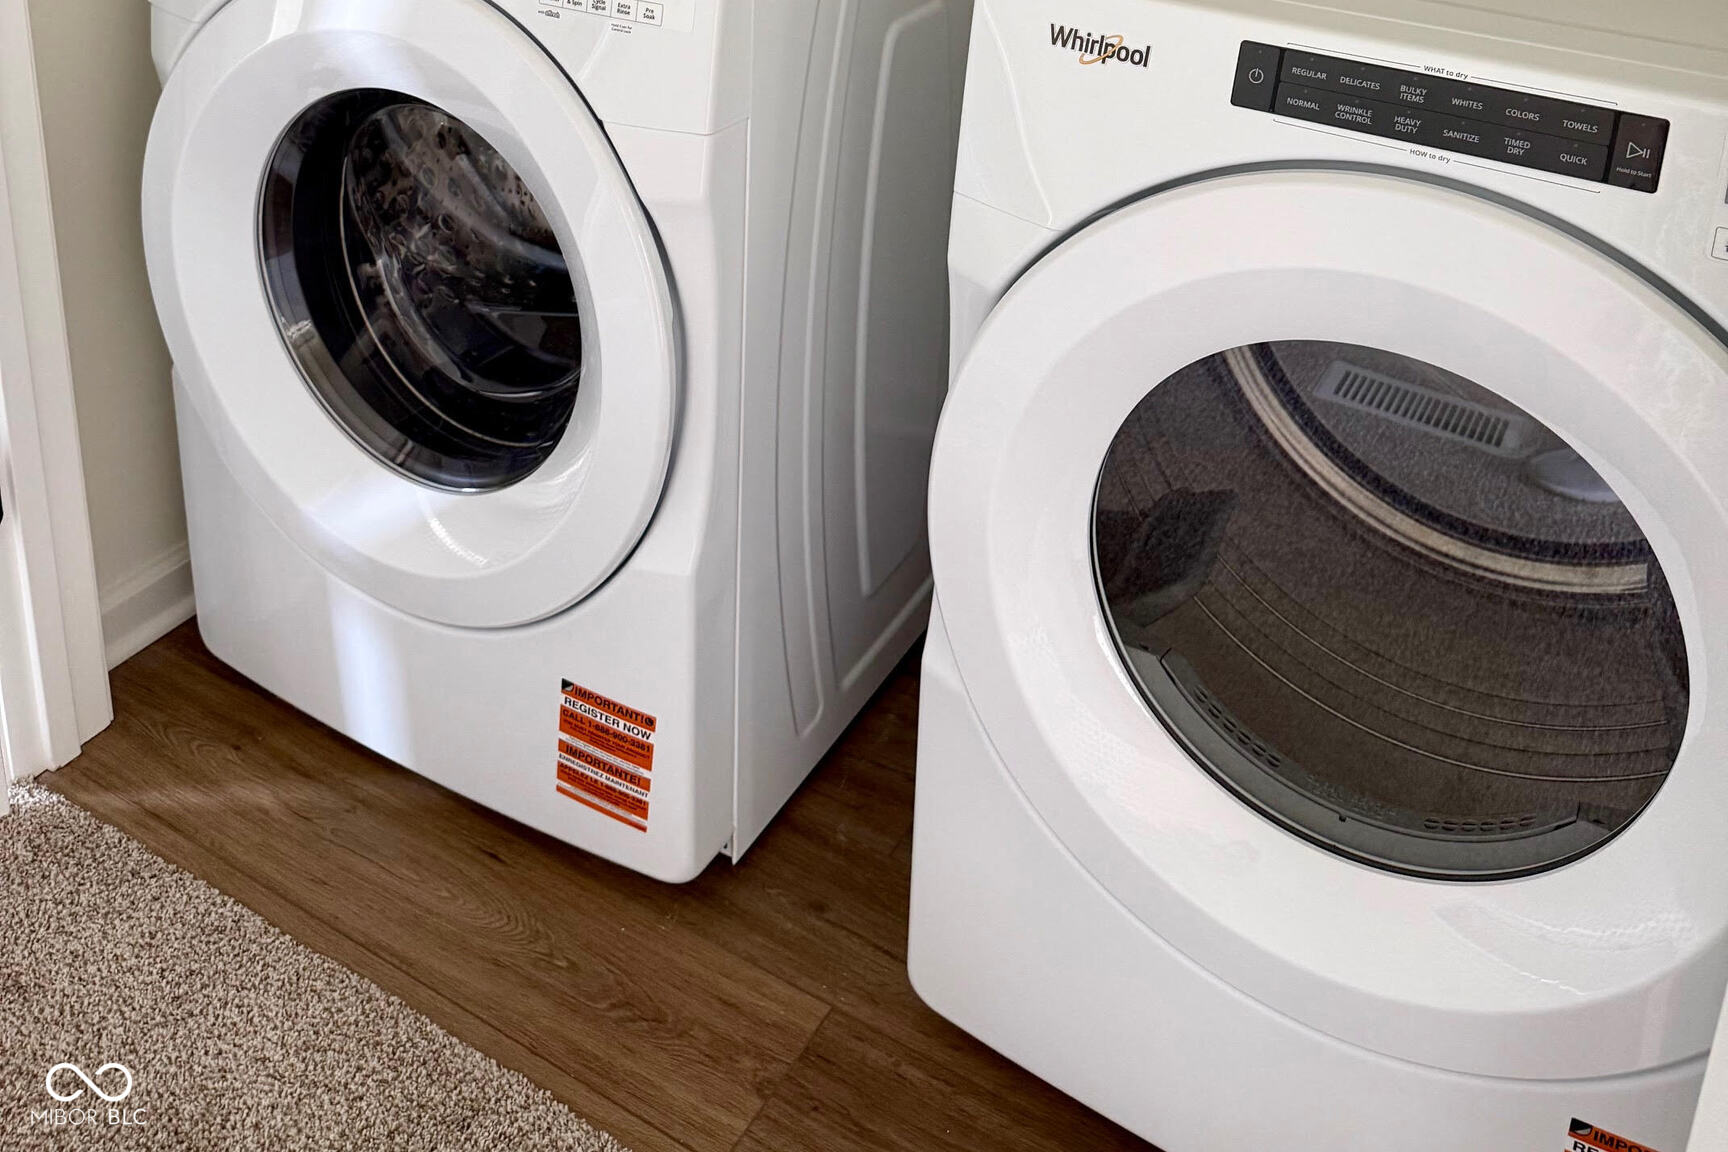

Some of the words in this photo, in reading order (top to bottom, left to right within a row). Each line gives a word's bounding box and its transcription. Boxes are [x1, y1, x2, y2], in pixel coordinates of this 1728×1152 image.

[571, 0, 582, 7] Spin
[591, 3, 607, 11] Signal
[618, 2, 631, 10] Extra
[1050, 23, 1151, 68] Whirlpool
[1291, 67, 1327, 80] REGULAR
[1424, 64, 1445, 75] WHAT
[1455, 72, 1468, 80] dry
[1340, 76, 1380, 90] DELICATES
[1400, 84, 1427, 96] BULKY
[1286, 97, 1320, 111] NORMAL
[1399, 92, 1425, 104] ITEMS
[1451, 97, 1483, 110] WHITES
[1337, 103, 1373, 117] WRINKLE
[1505, 108, 1540, 121] COLORS
[1334, 111, 1372, 125] CONTROL
[1394, 115, 1421, 127] HEAVY
[1394, 123, 1418, 134] DUTY
[1562, 119, 1598, 133] TOWELS
[1443, 129, 1480, 143] SANITIZE
[1504, 137, 1531, 149] TIMED
[1410, 148, 1428, 158] HOW
[1438, 155, 1451, 164] dry
[1507, 146, 1525, 156] DRY
[1560, 153, 1588, 166] QUICK
[575, 685, 644, 725] IMPORTANT!
[562, 708, 586, 725] CALL
[564, 696, 620, 729] REGISTER
[623, 723, 652, 741] NOW
